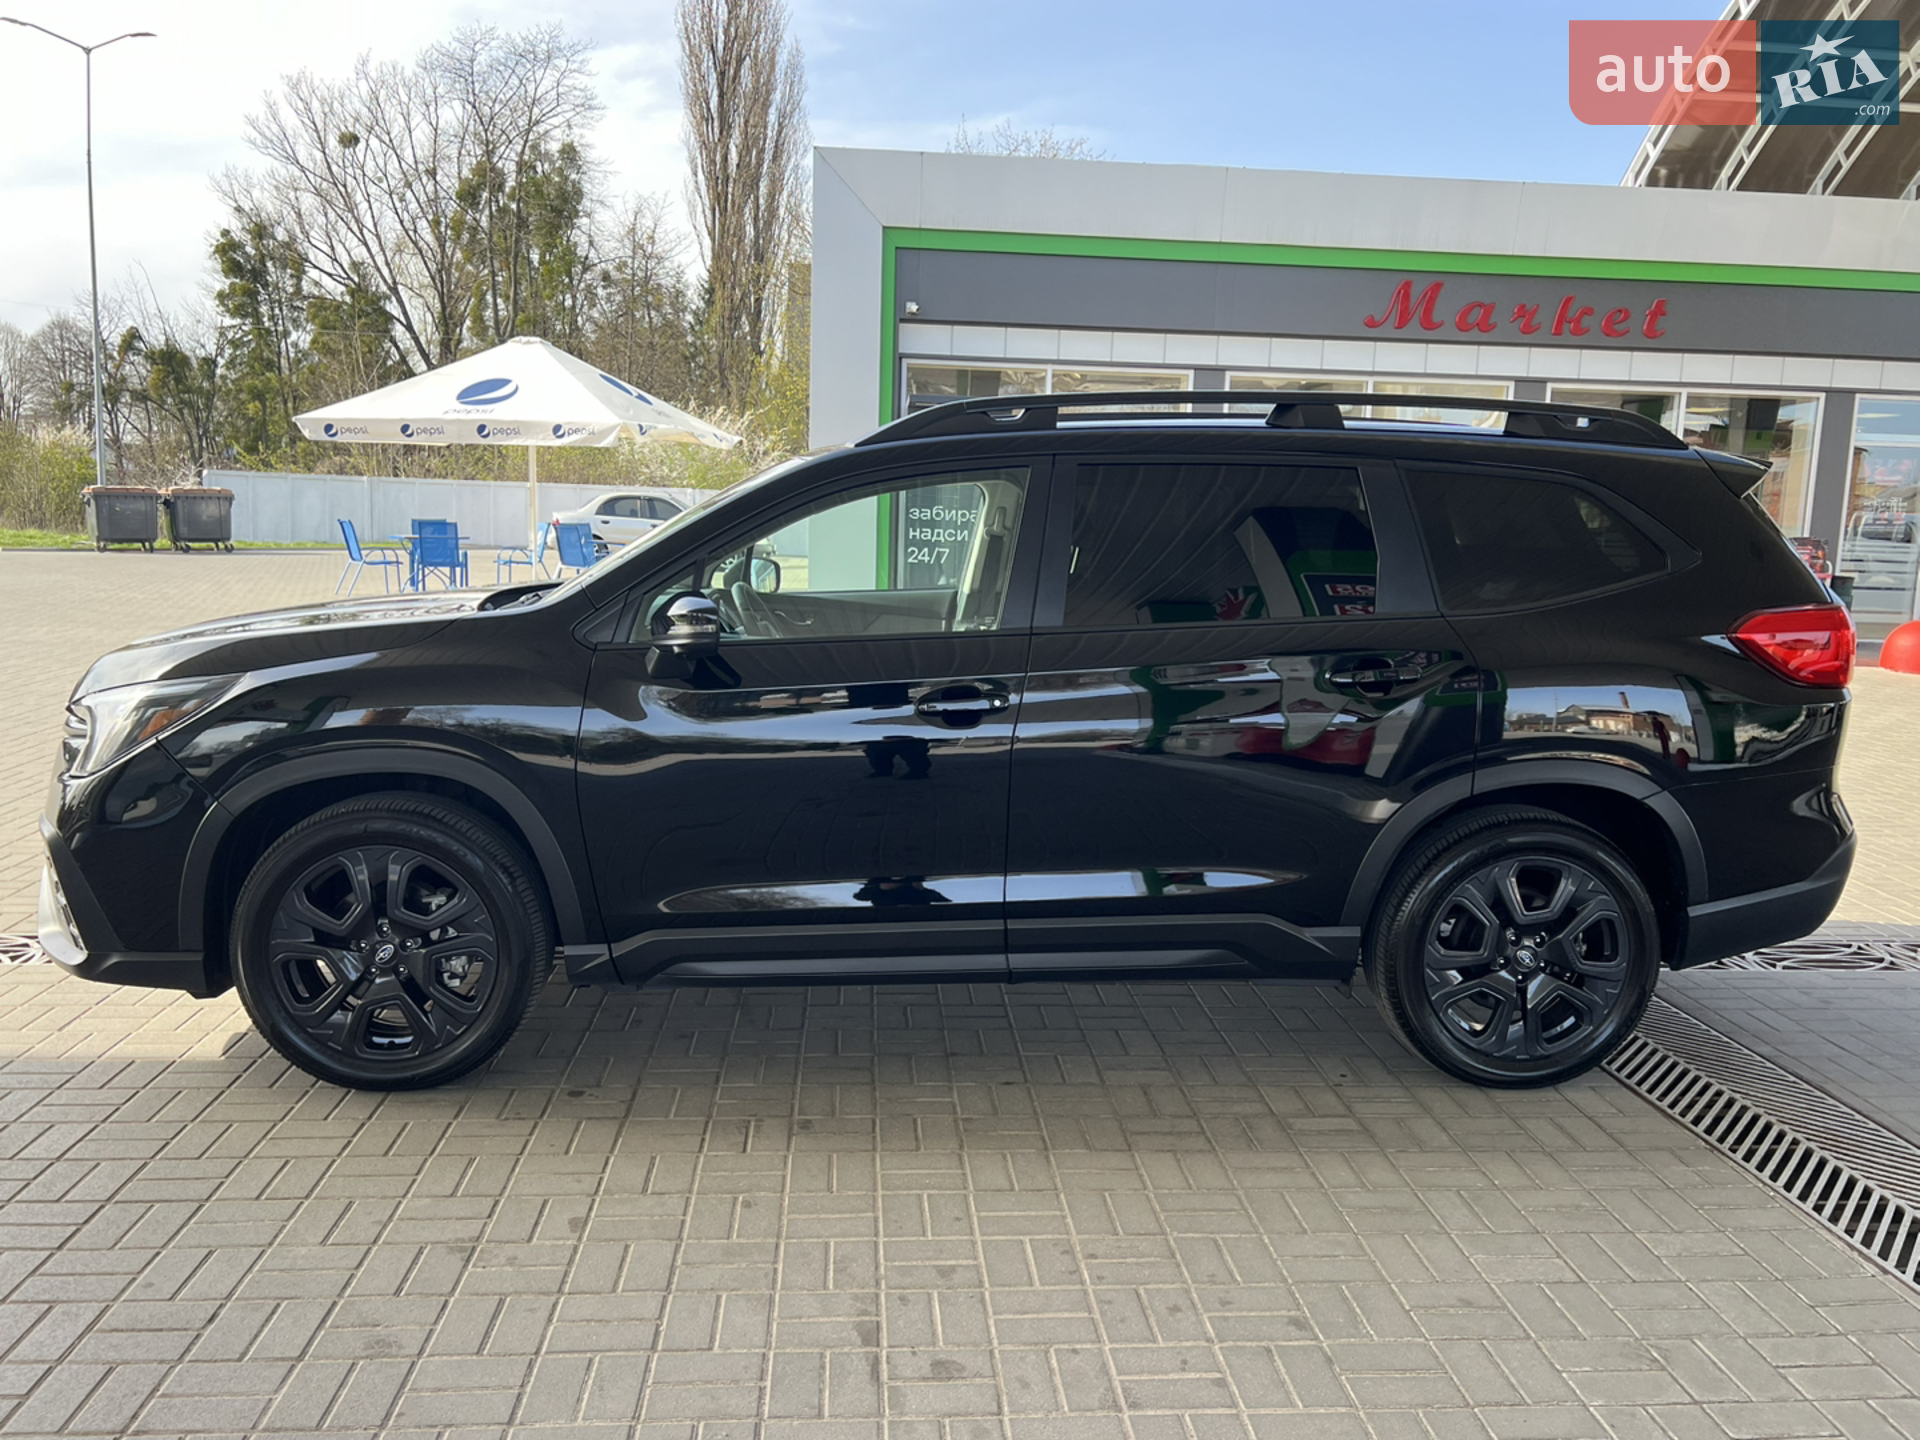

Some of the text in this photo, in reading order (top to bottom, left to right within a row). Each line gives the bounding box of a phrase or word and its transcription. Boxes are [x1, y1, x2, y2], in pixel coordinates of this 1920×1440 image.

[1363, 279, 1669, 340] Market
[339, 426, 370, 436] pepsi
[415, 426, 446, 437] pepsi
[491, 426, 522, 437] pepsi
[566, 426, 597, 437] pepsi
[908, 527, 969, 542] надси
[907, 547, 950, 565] 24/7
